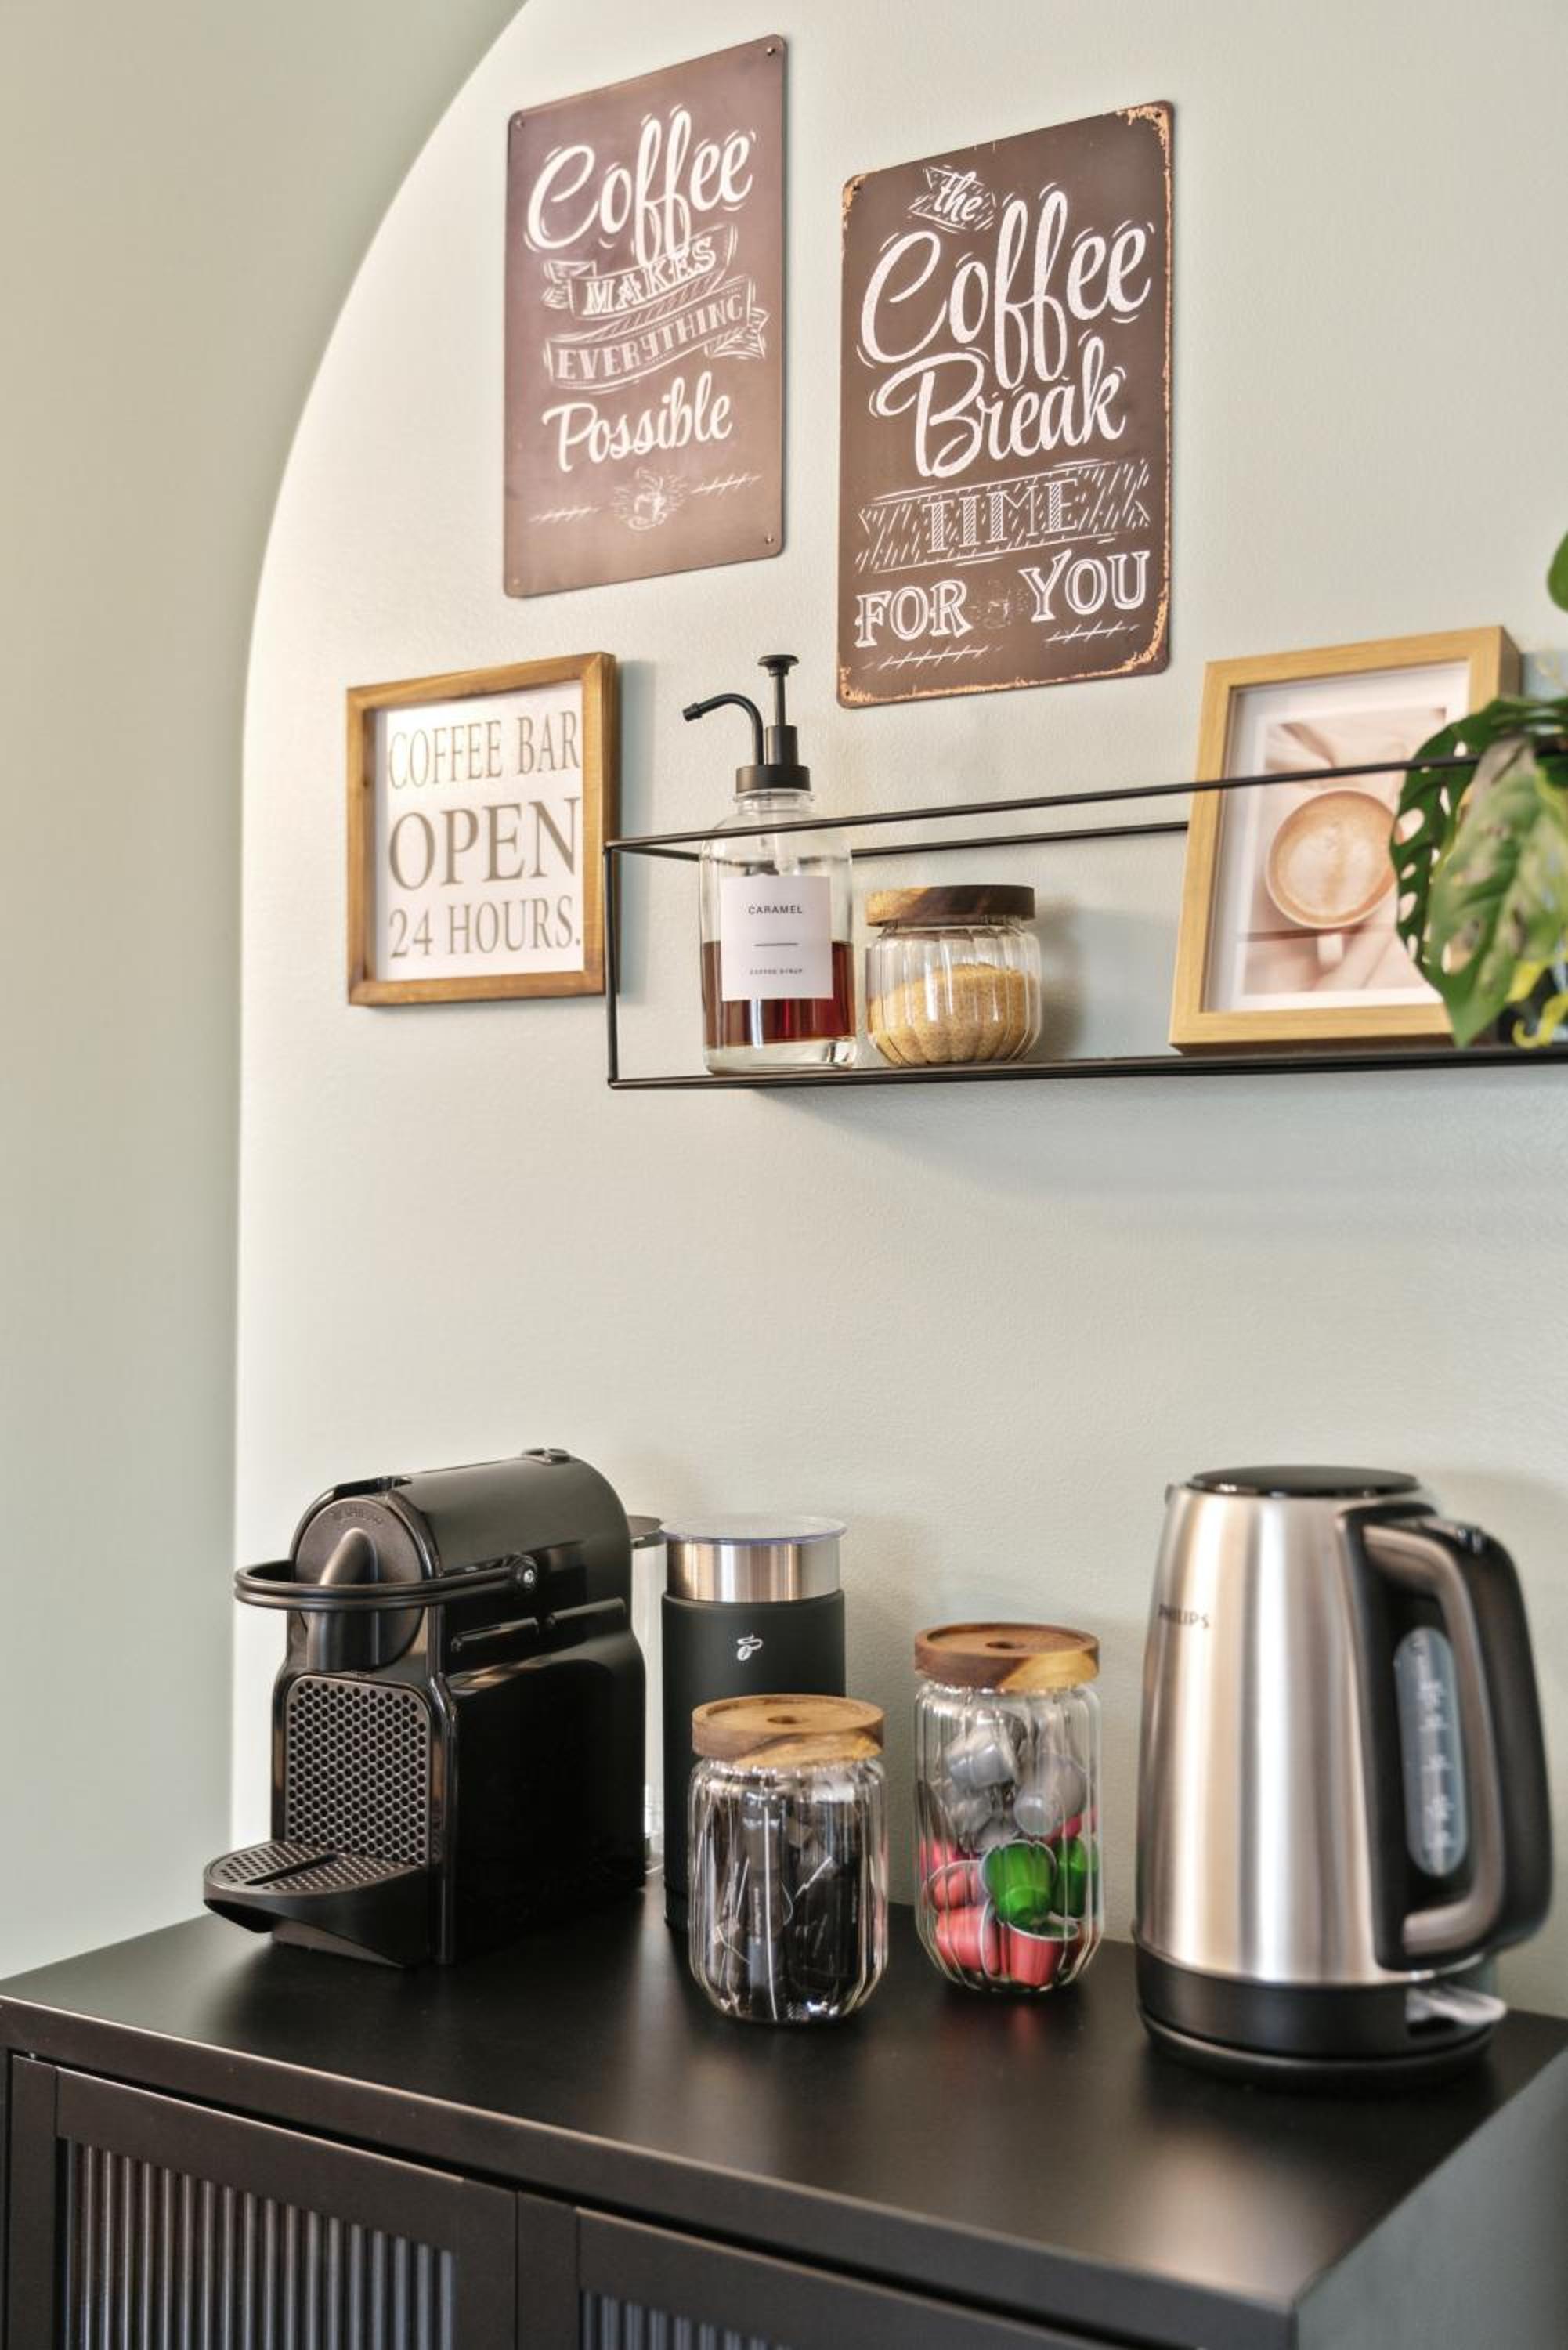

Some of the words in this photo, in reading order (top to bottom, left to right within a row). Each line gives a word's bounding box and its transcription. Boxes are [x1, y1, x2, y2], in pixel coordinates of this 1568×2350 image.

[528, 109, 753, 268] Coffee
[934, 171, 984, 222] the
[582, 237, 717, 316] MAKES
[860, 190, 1152, 390] Coffee
[557, 290, 746, 380] EVERYTHING
[542, 371, 733, 472] Possible
[875, 336, 1125, 478] Break
[923, 478, 1078, 554] TIME
[854, 579, 974, 649] FOR
[1018, 549, 1151, 624] YOU
[388, 719, 503, 790] COFFEE
[517, 710, 580, 775] BAR
[388, 796, 581, 891] OPEN
[390, 907, 434, 959] 24
[448, 895, 581, 955] HOURS.
[748, 905, 803, 914] CARAMEL
